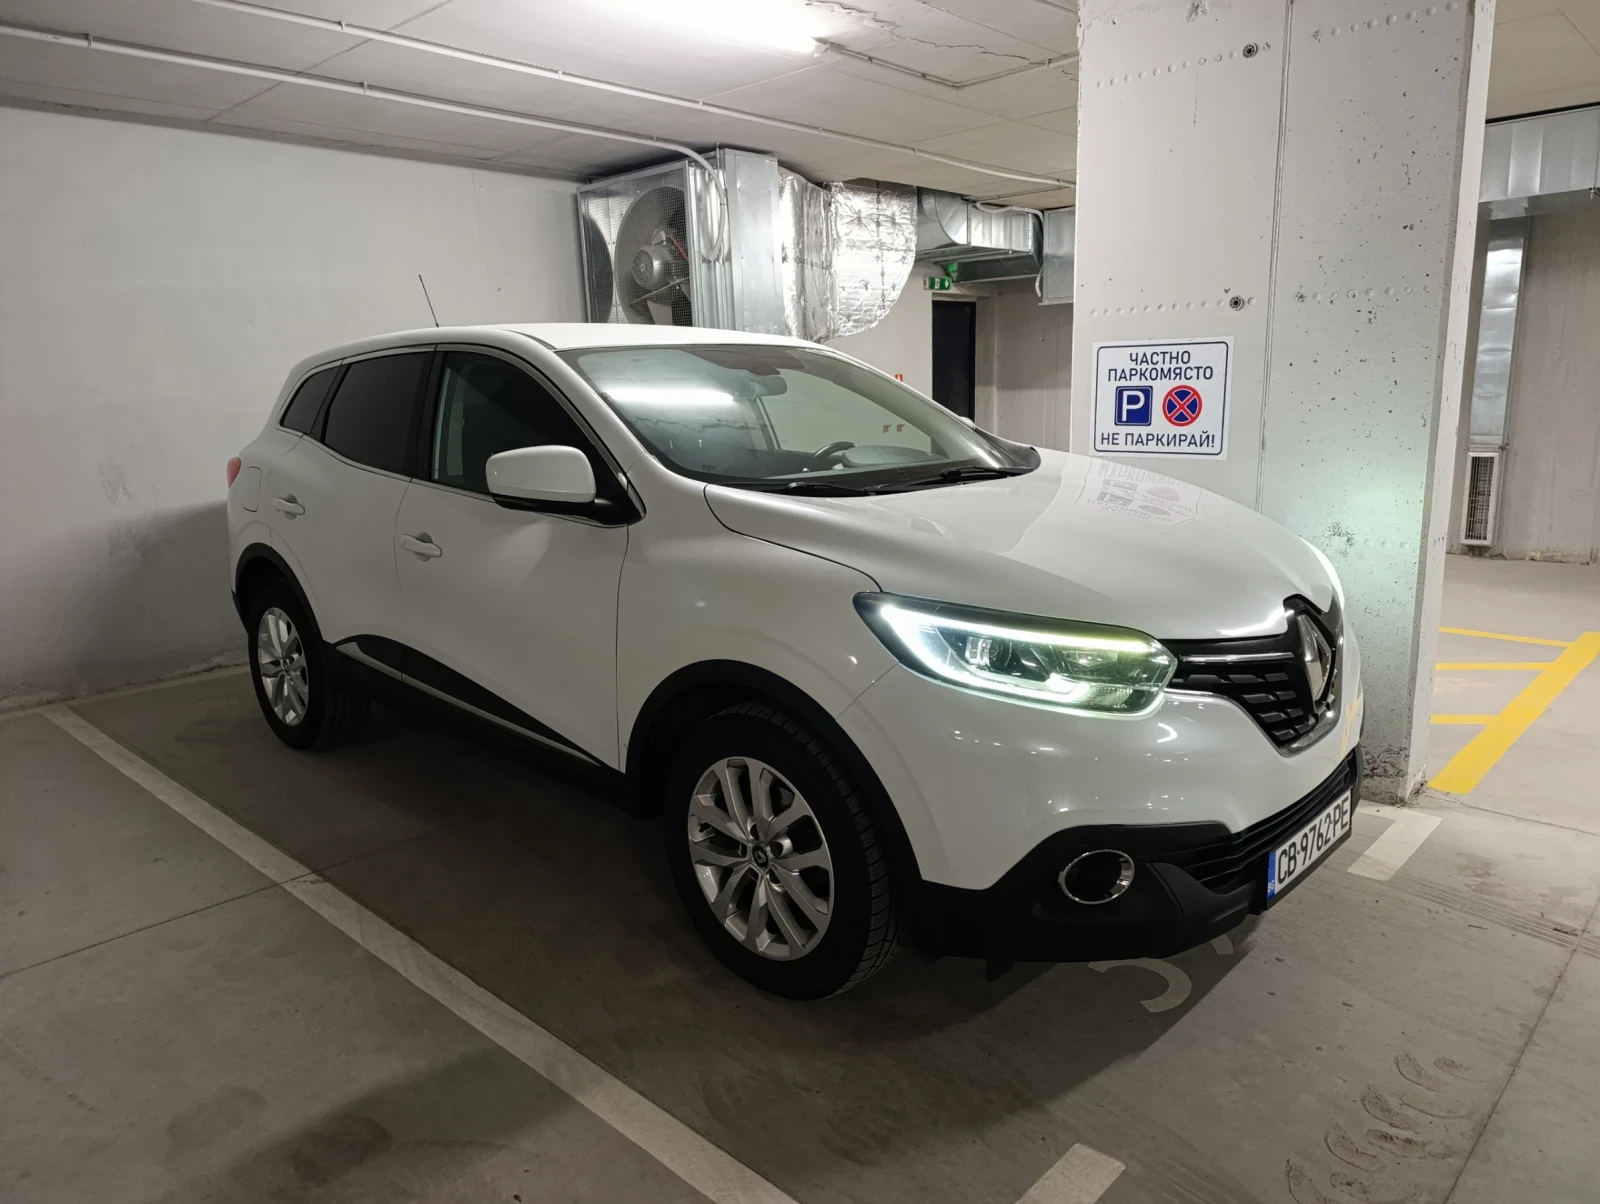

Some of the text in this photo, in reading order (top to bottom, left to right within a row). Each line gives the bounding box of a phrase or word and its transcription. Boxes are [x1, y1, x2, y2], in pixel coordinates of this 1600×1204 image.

[1129, 350, 1191, 366] ЧАСТНО
[1108, 366, 1214, 382] ПАРКОМЯСТО
[1100, 430, 1215, 448] НЕ ПАРКИРАЙ!
